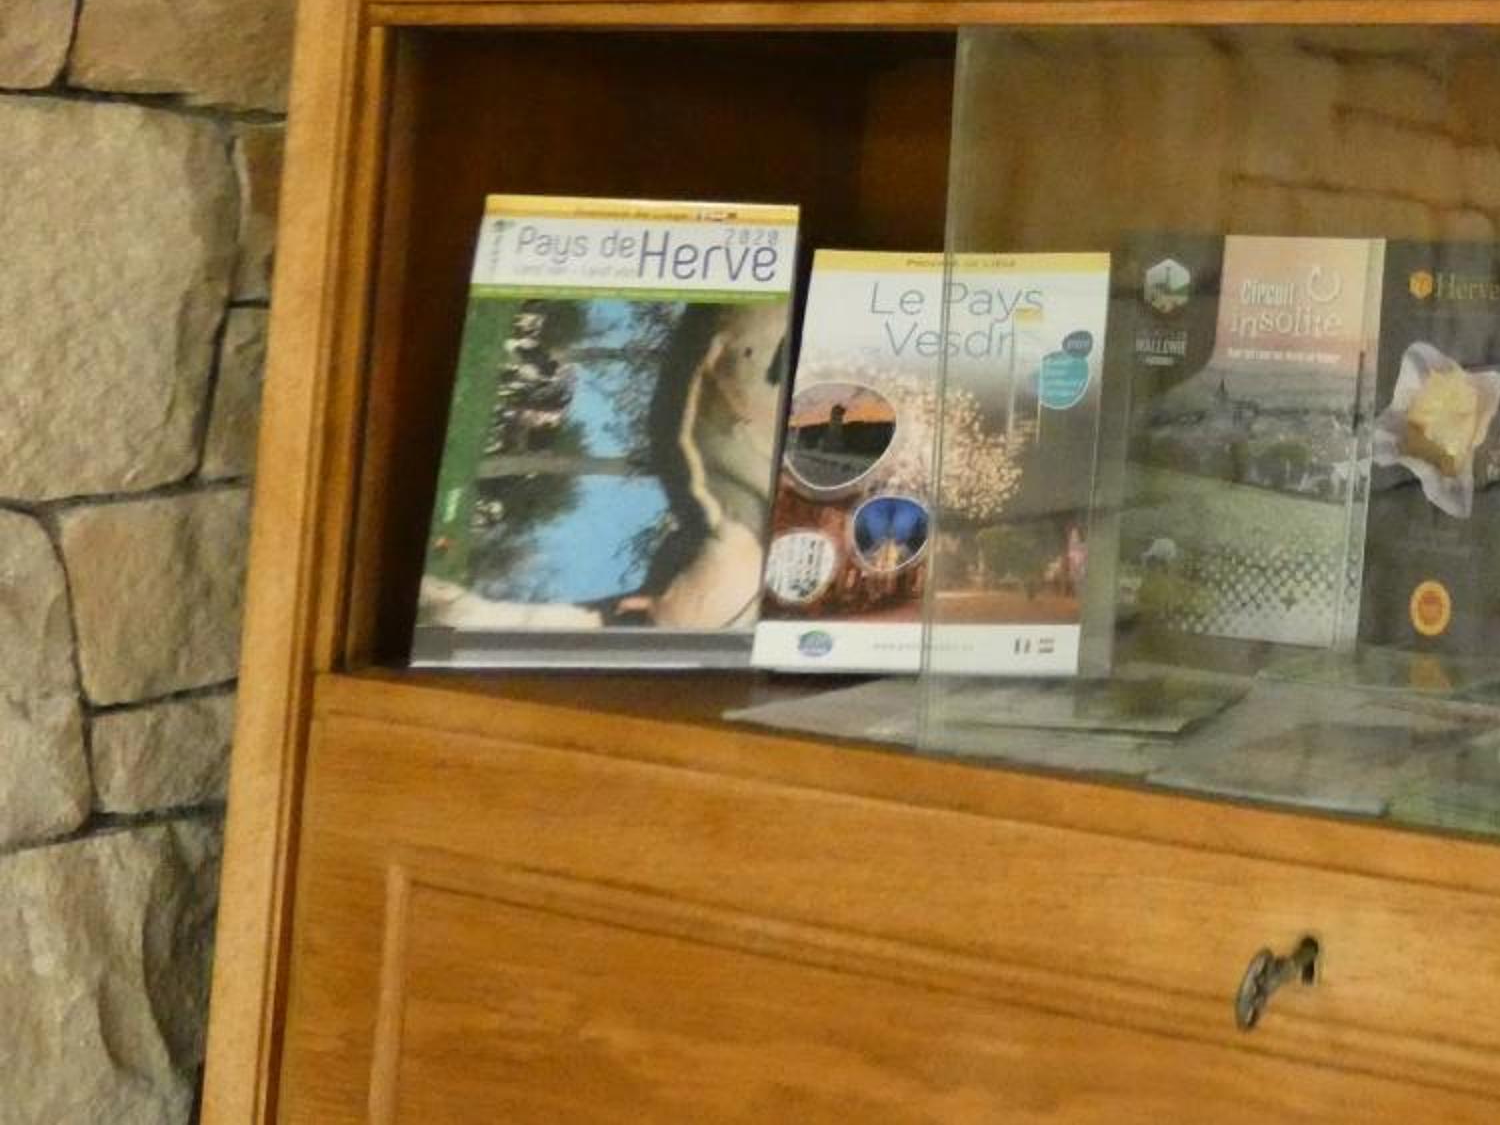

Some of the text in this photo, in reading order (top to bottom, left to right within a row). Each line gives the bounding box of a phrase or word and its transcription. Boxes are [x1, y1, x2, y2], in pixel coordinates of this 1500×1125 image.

[515, 225, 589, 264] Pays
[600, 229, 637, 259] de
[638, 230, 778, 282] Herve
[870, 281, 1046, 324] Le Pays
[885, 319, 1018, 359] Vesdr
